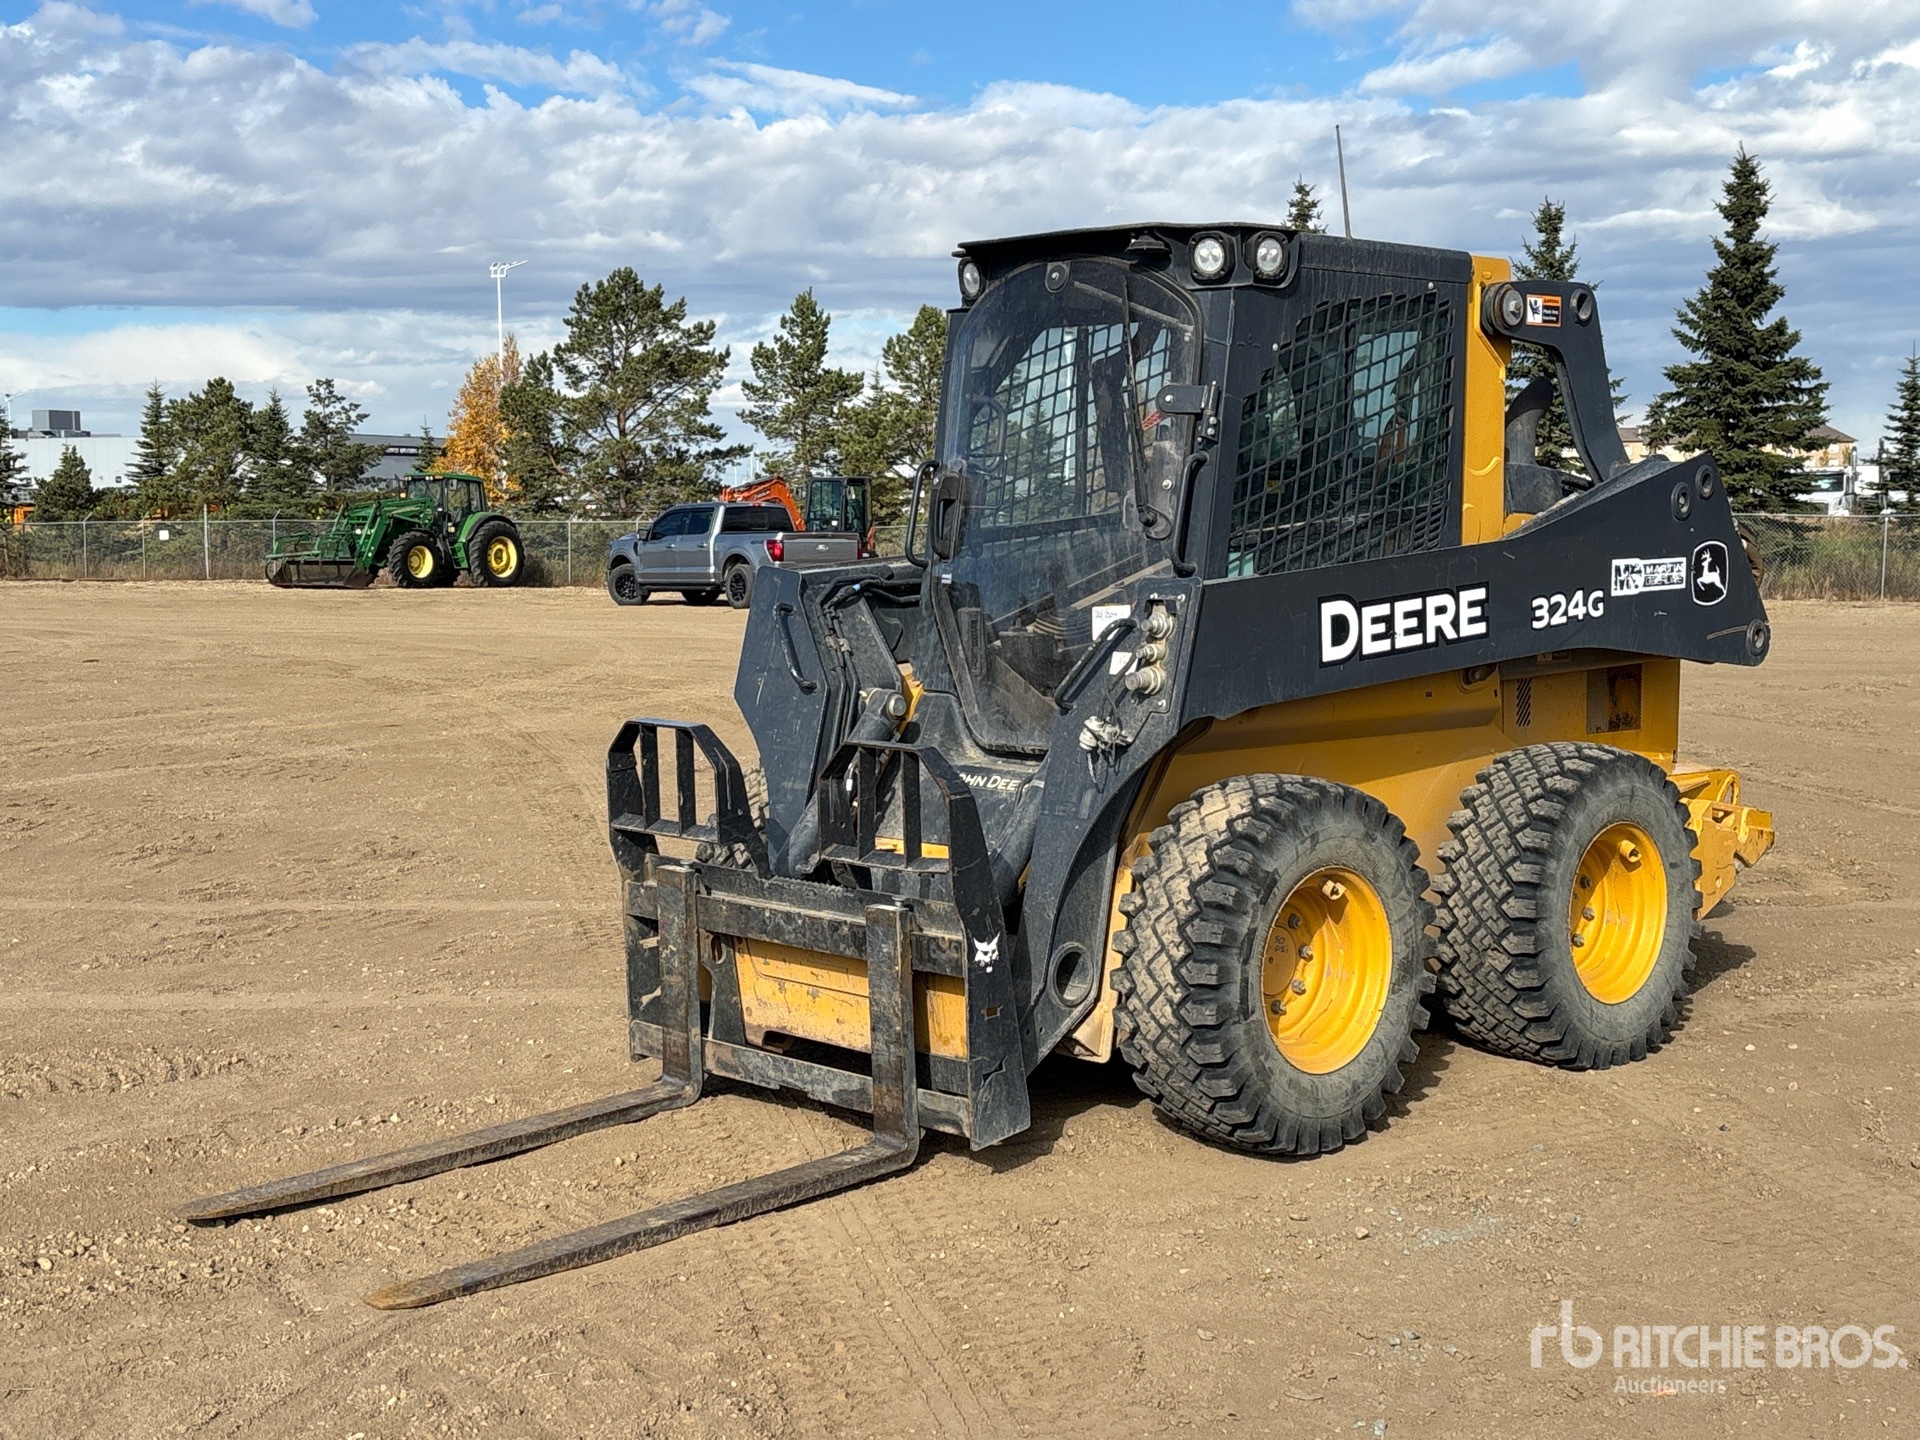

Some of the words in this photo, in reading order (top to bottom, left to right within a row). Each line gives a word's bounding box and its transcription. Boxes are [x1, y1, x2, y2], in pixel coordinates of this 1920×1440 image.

[1320, 587, 1487, 663] DEERE
[1532, 589, 1604, 629] 324G
[987, 775, 1022, 790] DEE
